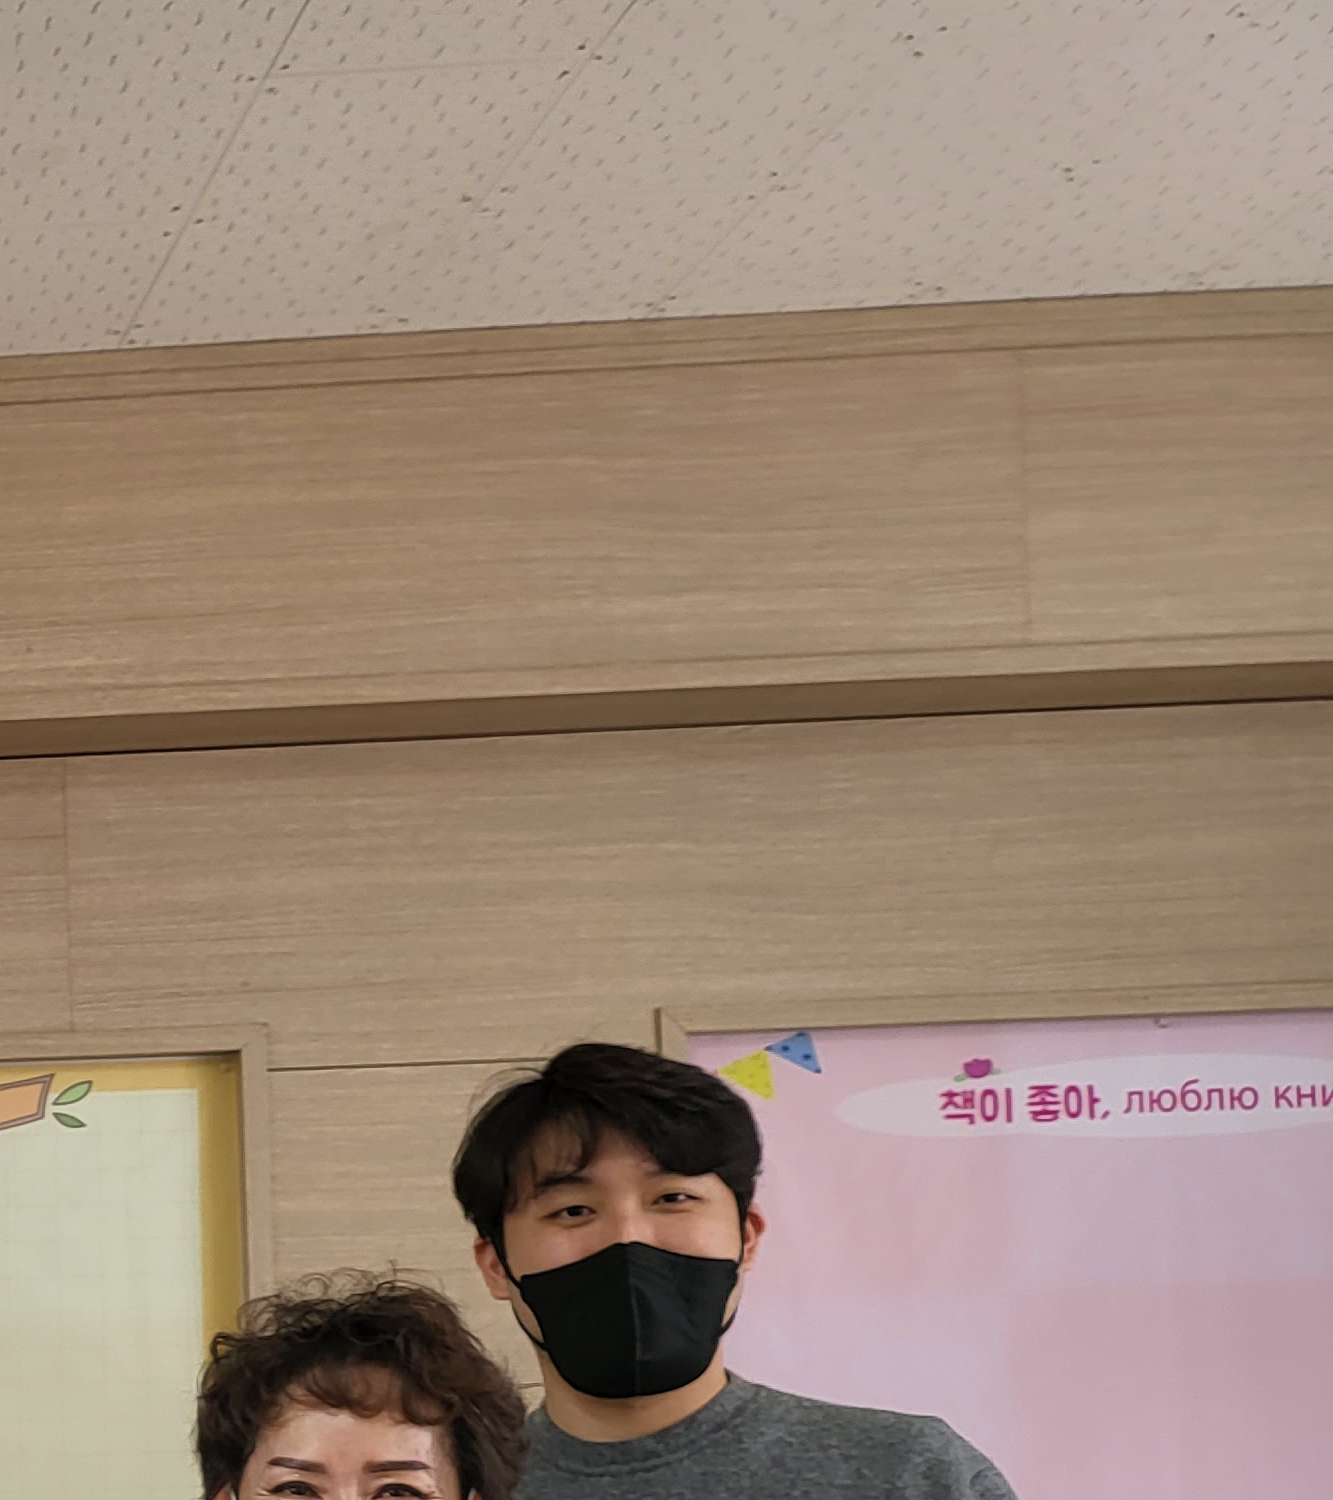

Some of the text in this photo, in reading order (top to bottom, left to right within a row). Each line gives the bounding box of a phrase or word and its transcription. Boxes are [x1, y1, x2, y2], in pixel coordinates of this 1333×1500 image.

[939, 1089, 1013, 1125] 책이
[1025, 1084, 1111, 1123] 좋아,
[1123, 1078, 1259, 1114] люблю
